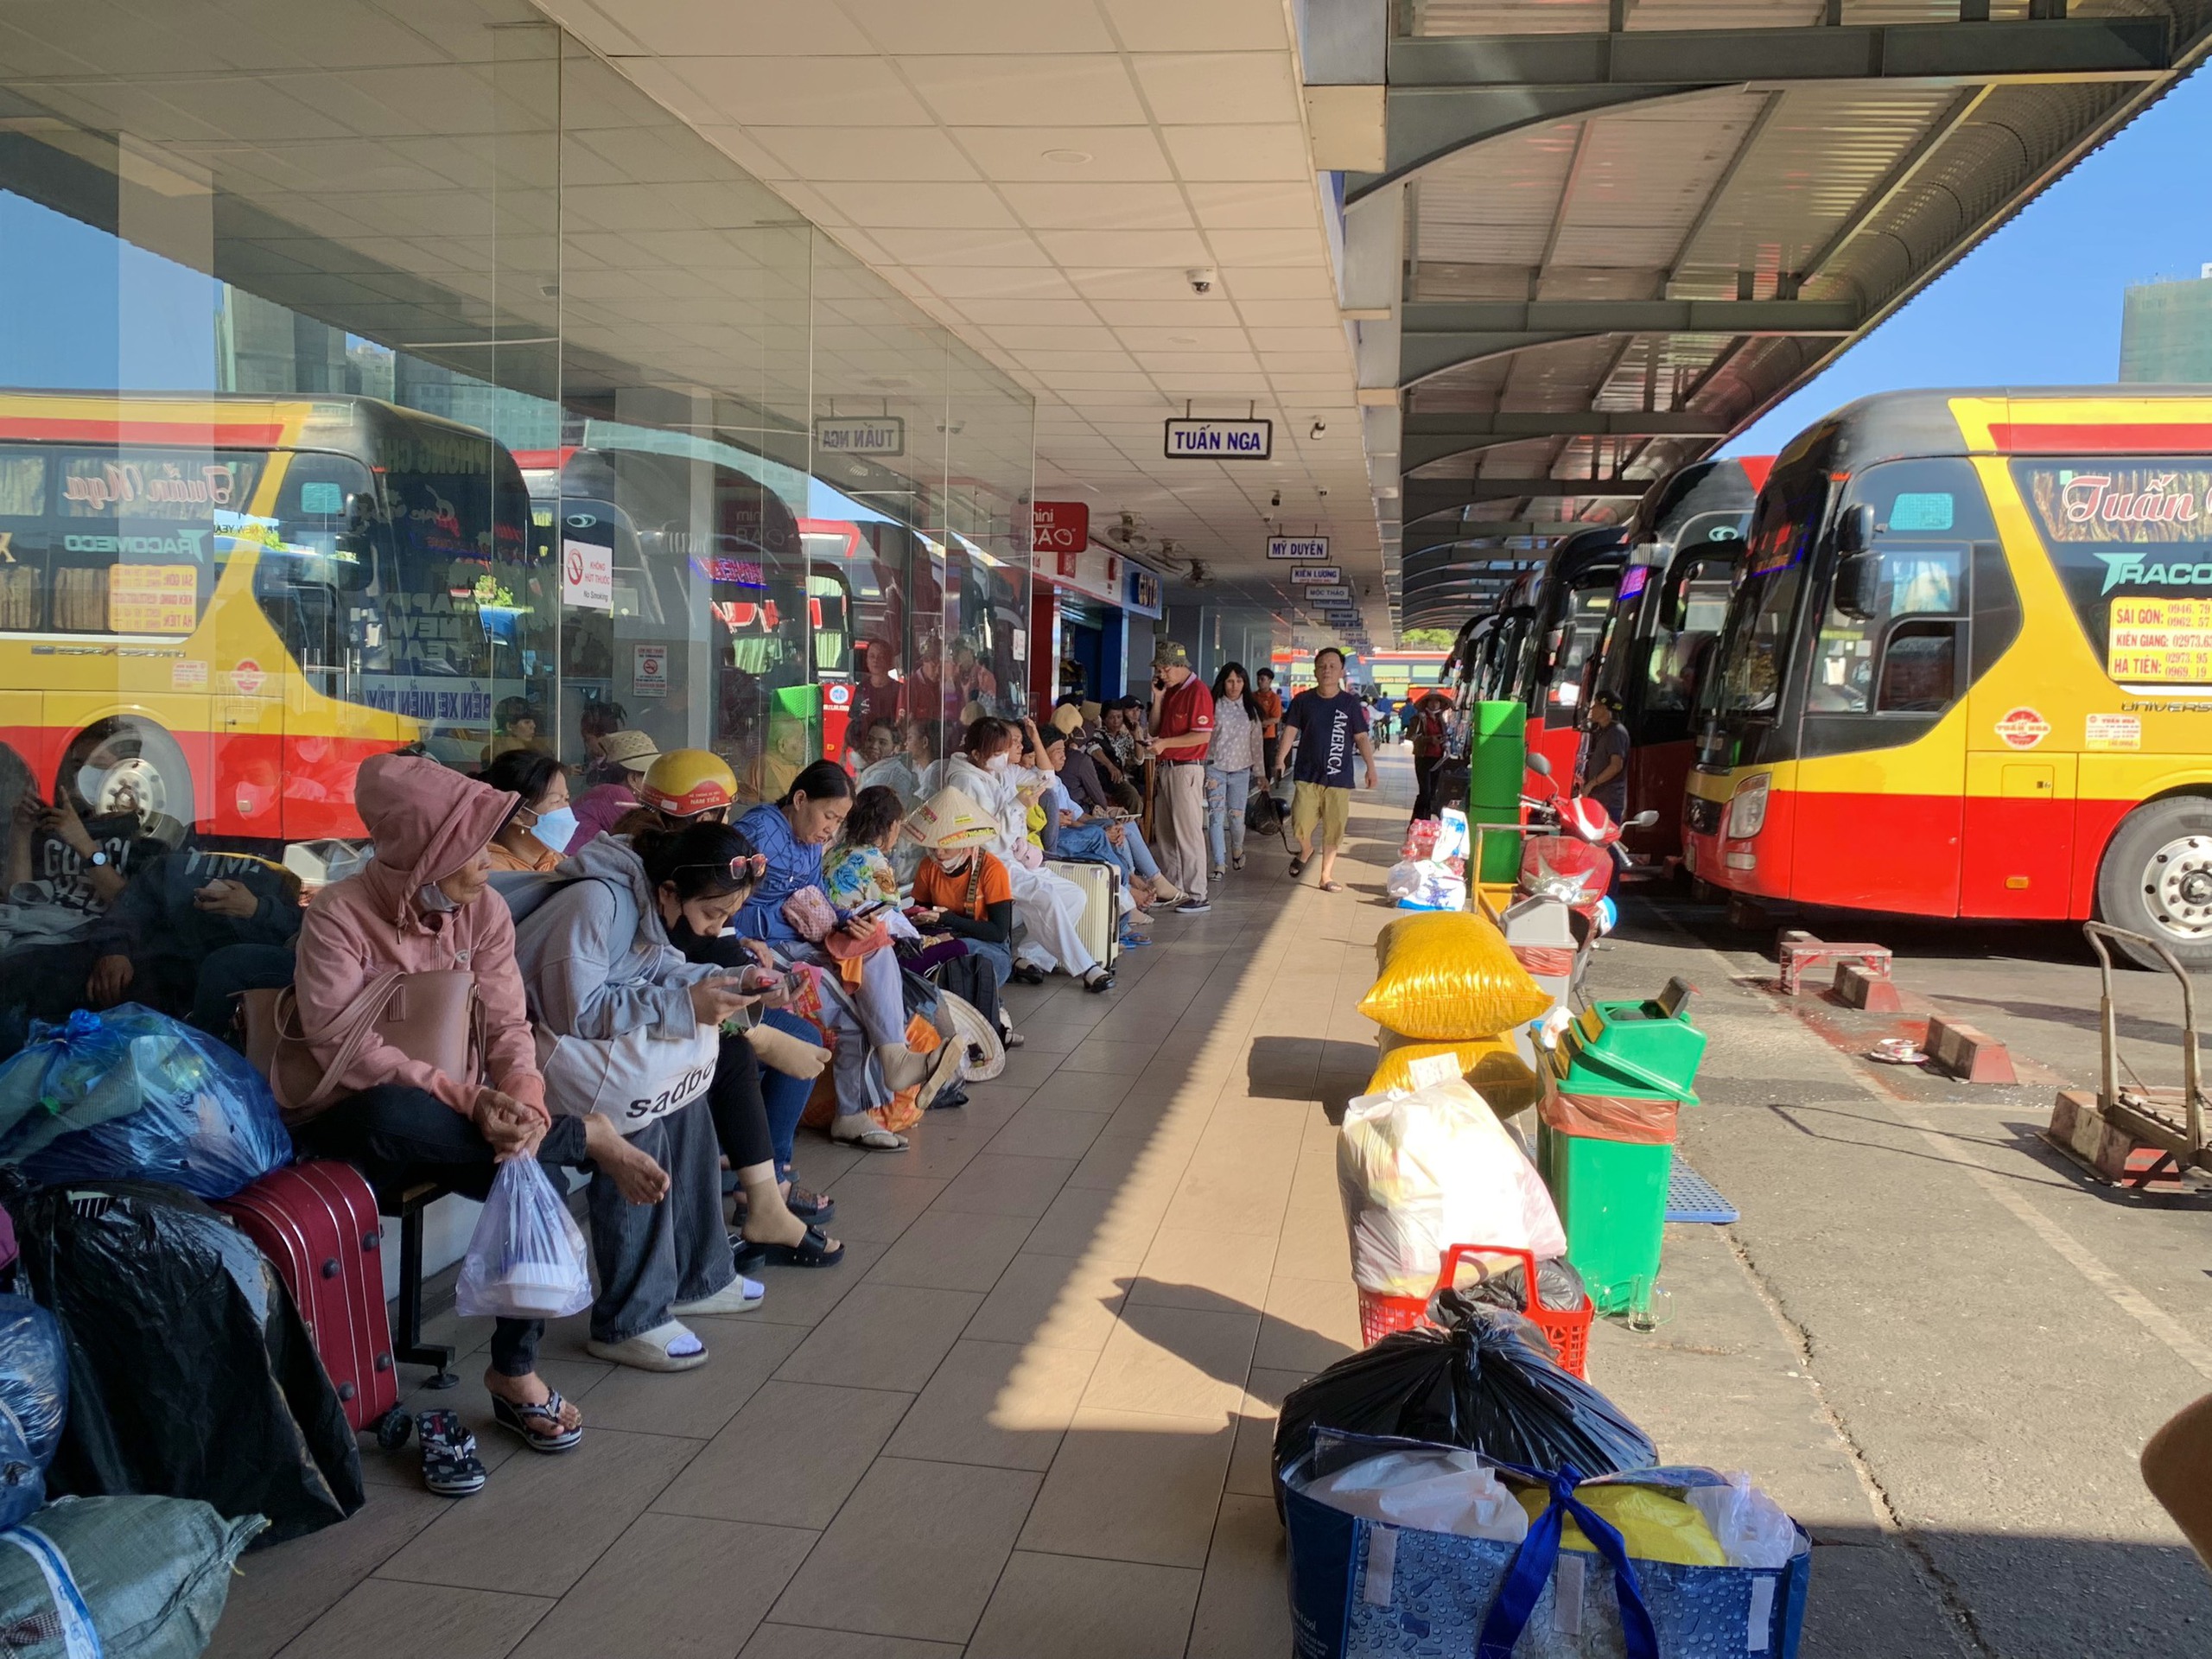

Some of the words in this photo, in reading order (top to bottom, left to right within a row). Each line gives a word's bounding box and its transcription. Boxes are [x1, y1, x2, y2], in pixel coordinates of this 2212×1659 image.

[1174, 424, 1220, 450] TUẤN
[1227, 432, 1261, 450] NGA
[2062, 474, 2198, 522] Tuấn
[1272, 540, 1287, 555] MỸ
[1290, 541, 1324, 555] DUYÊN
[590, 559, 606, 571] KHÔNG
[584, 572, 594, 583] HÚT
[595, 573, 611, 586] THUỐC
[2093, 552, 2212, 597] TRACO
[590, 591, 608, 602] Smoking
[2199, 604, 2211, 614] 79
[2198, 617, 2210, 627] 57
[2116, 631, 2137, 646] KIÊN
[2140, 634, 2169, 647] GIANG:
[2133, 654, 2161, 673] TIÊN:
[1326, 709, 1348, 775] AMERICA
